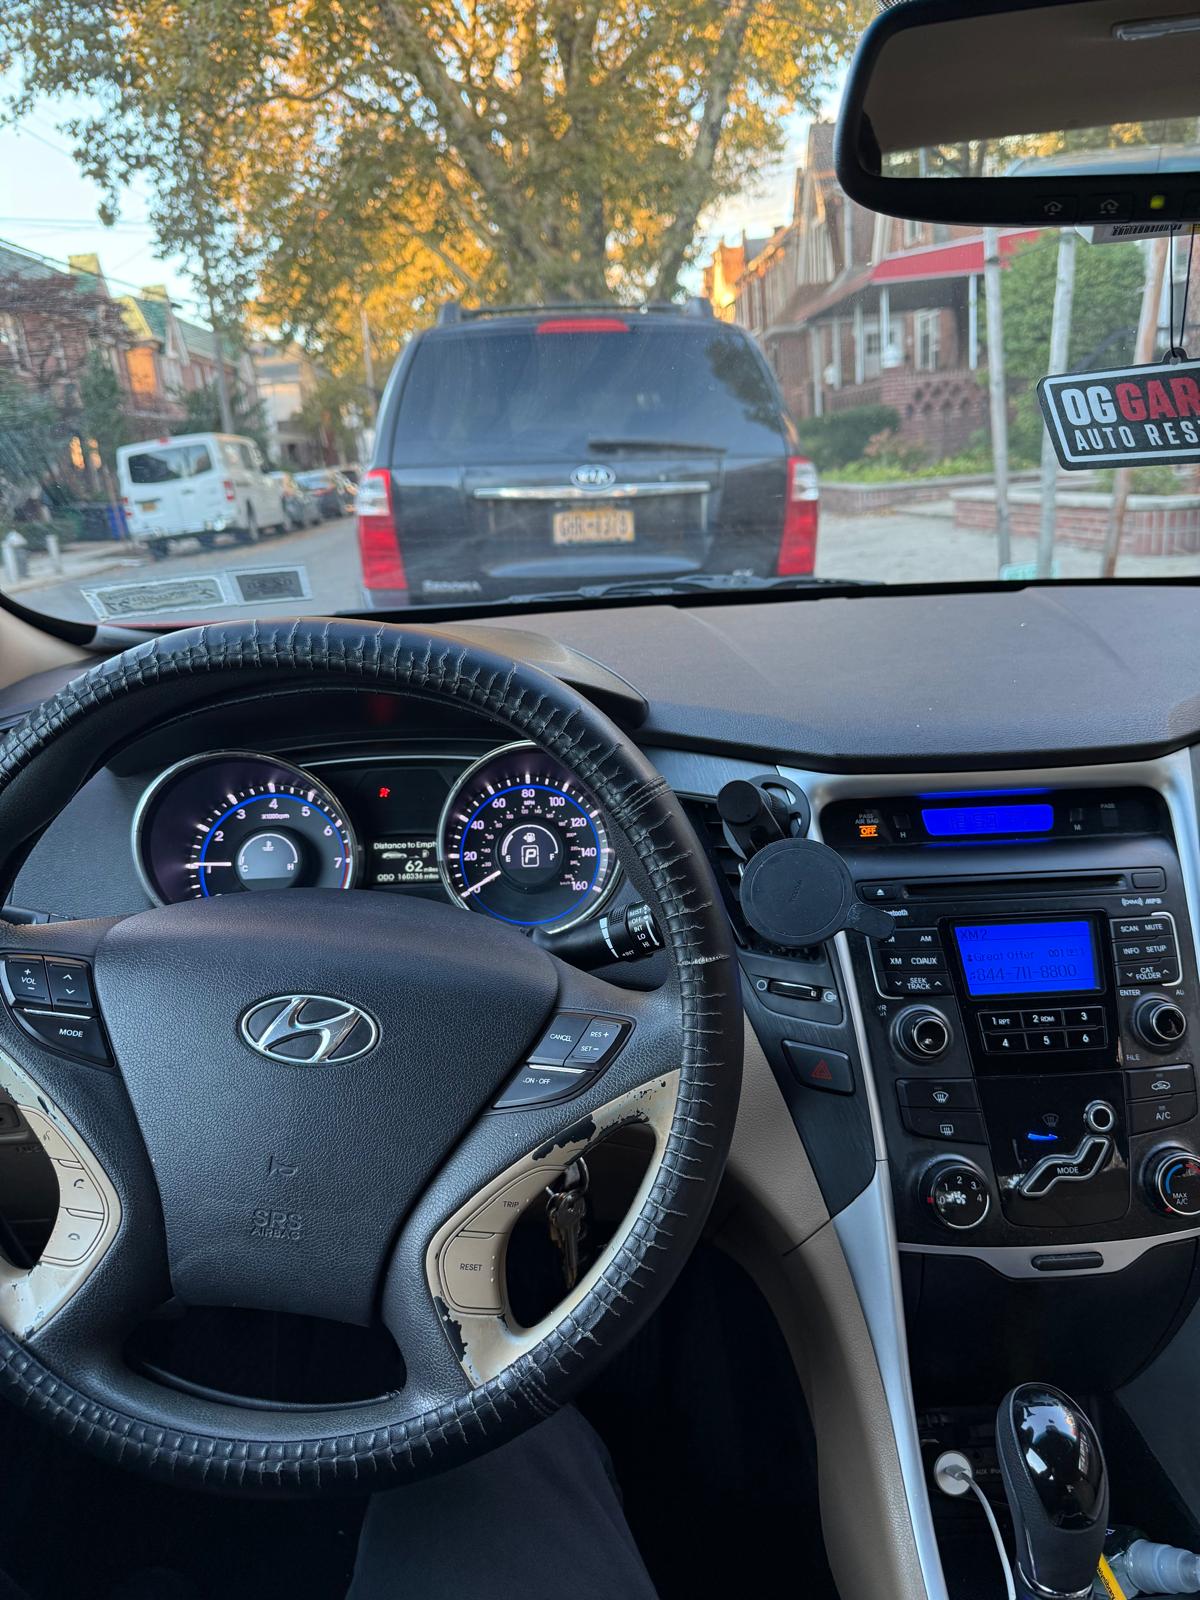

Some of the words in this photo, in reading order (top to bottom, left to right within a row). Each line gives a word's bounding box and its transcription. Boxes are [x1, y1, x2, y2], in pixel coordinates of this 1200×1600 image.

[1073, 426, 1136, 451] AUTO
[1144, 421, 1200, 446] RES
[521, 788, 535, 798] 80
[269, 798, 278, 810] 4
[492, 798, 506, 808] 60
[549, 796, 566, 807] 100
[236, 809, 246, 820] 3
[301, 806, 311, 817] 5
[470, 820, 485, 830] 40
[570, 817, 587, 827] 120
[323, 825, 333, 836] 6
[860, 827, 877, 835] OFF
[1073, 823, 1082, 831] M
[214, 830, 224, 841] 2
[373, 842, 407, 850] Distance
[407, 841, 416, 849] to
[416, 841, 438, 849] Empt
[463, 851, 477, 861] 20
[525, 849, 536, 864] P
[580, 847, 596, 857] 140
[505, 854, 511, 862] E
[549, 853, 555, 861] F
[334, 857, 342, 869] 7
[404, 860, 424, 873] 62
[377, 873, 395, 882] ODO
[571, 880, 588, 891] 160
[633, 924, 643, 933] INT
[1120, 925, 1140, 933] SCAN
[1144, 923, 1163, 931] MUTE
[636, 933, 647, 941] LO
[642, 941, 651, 949] HI
[1122, 946, 1140, 955] INFO
[1145, 944, 1167, 953] SETUP
[974, 951, 1004, 962] Great
[1006, 950, 1034, 961] Offer
[889, 957, 902, 965] XM
[910, 957, 938, 965] CD/AUX
[1140, 966, 1154, 974] CAT
[1135, 971, 1161, 980] FOLDER
[21, 976, 37, 985] VOL
[907, 982, 931, 990] TRACK
[1119, 989, 1141, 997] ENTER
[1032, 1014, 1039, 1023] 2
[1080, 1011, 1088, 1020] 3
[991, 1016, 997, 1025] 1
[59, 1028, 84, 1038] MODE
[549, 1033, 572, 1042] CANCEL
[1002, 1038, 1010, 1047] 4
[1043, 1035, 1050, 1045] 5
[1082, 1033, 1089, 1043] 6
[1155, 1111, 1171, 1120] A/C
[1056, 1166, 1079, 1175] MODE
[956, 1175, 963, 1185] 2
[944, 1182, 948, 1191] 1
[970, 1181, 977, 1190] 3
[976, 1193, 982, 1202] 4
[503, 1200, 520, 1208] TRIP
[253, 1210, 302, 1230] SRS
[250, 1227, 301, 1240] AIRBAG
[459, 1263, 483, 1271] RESET
